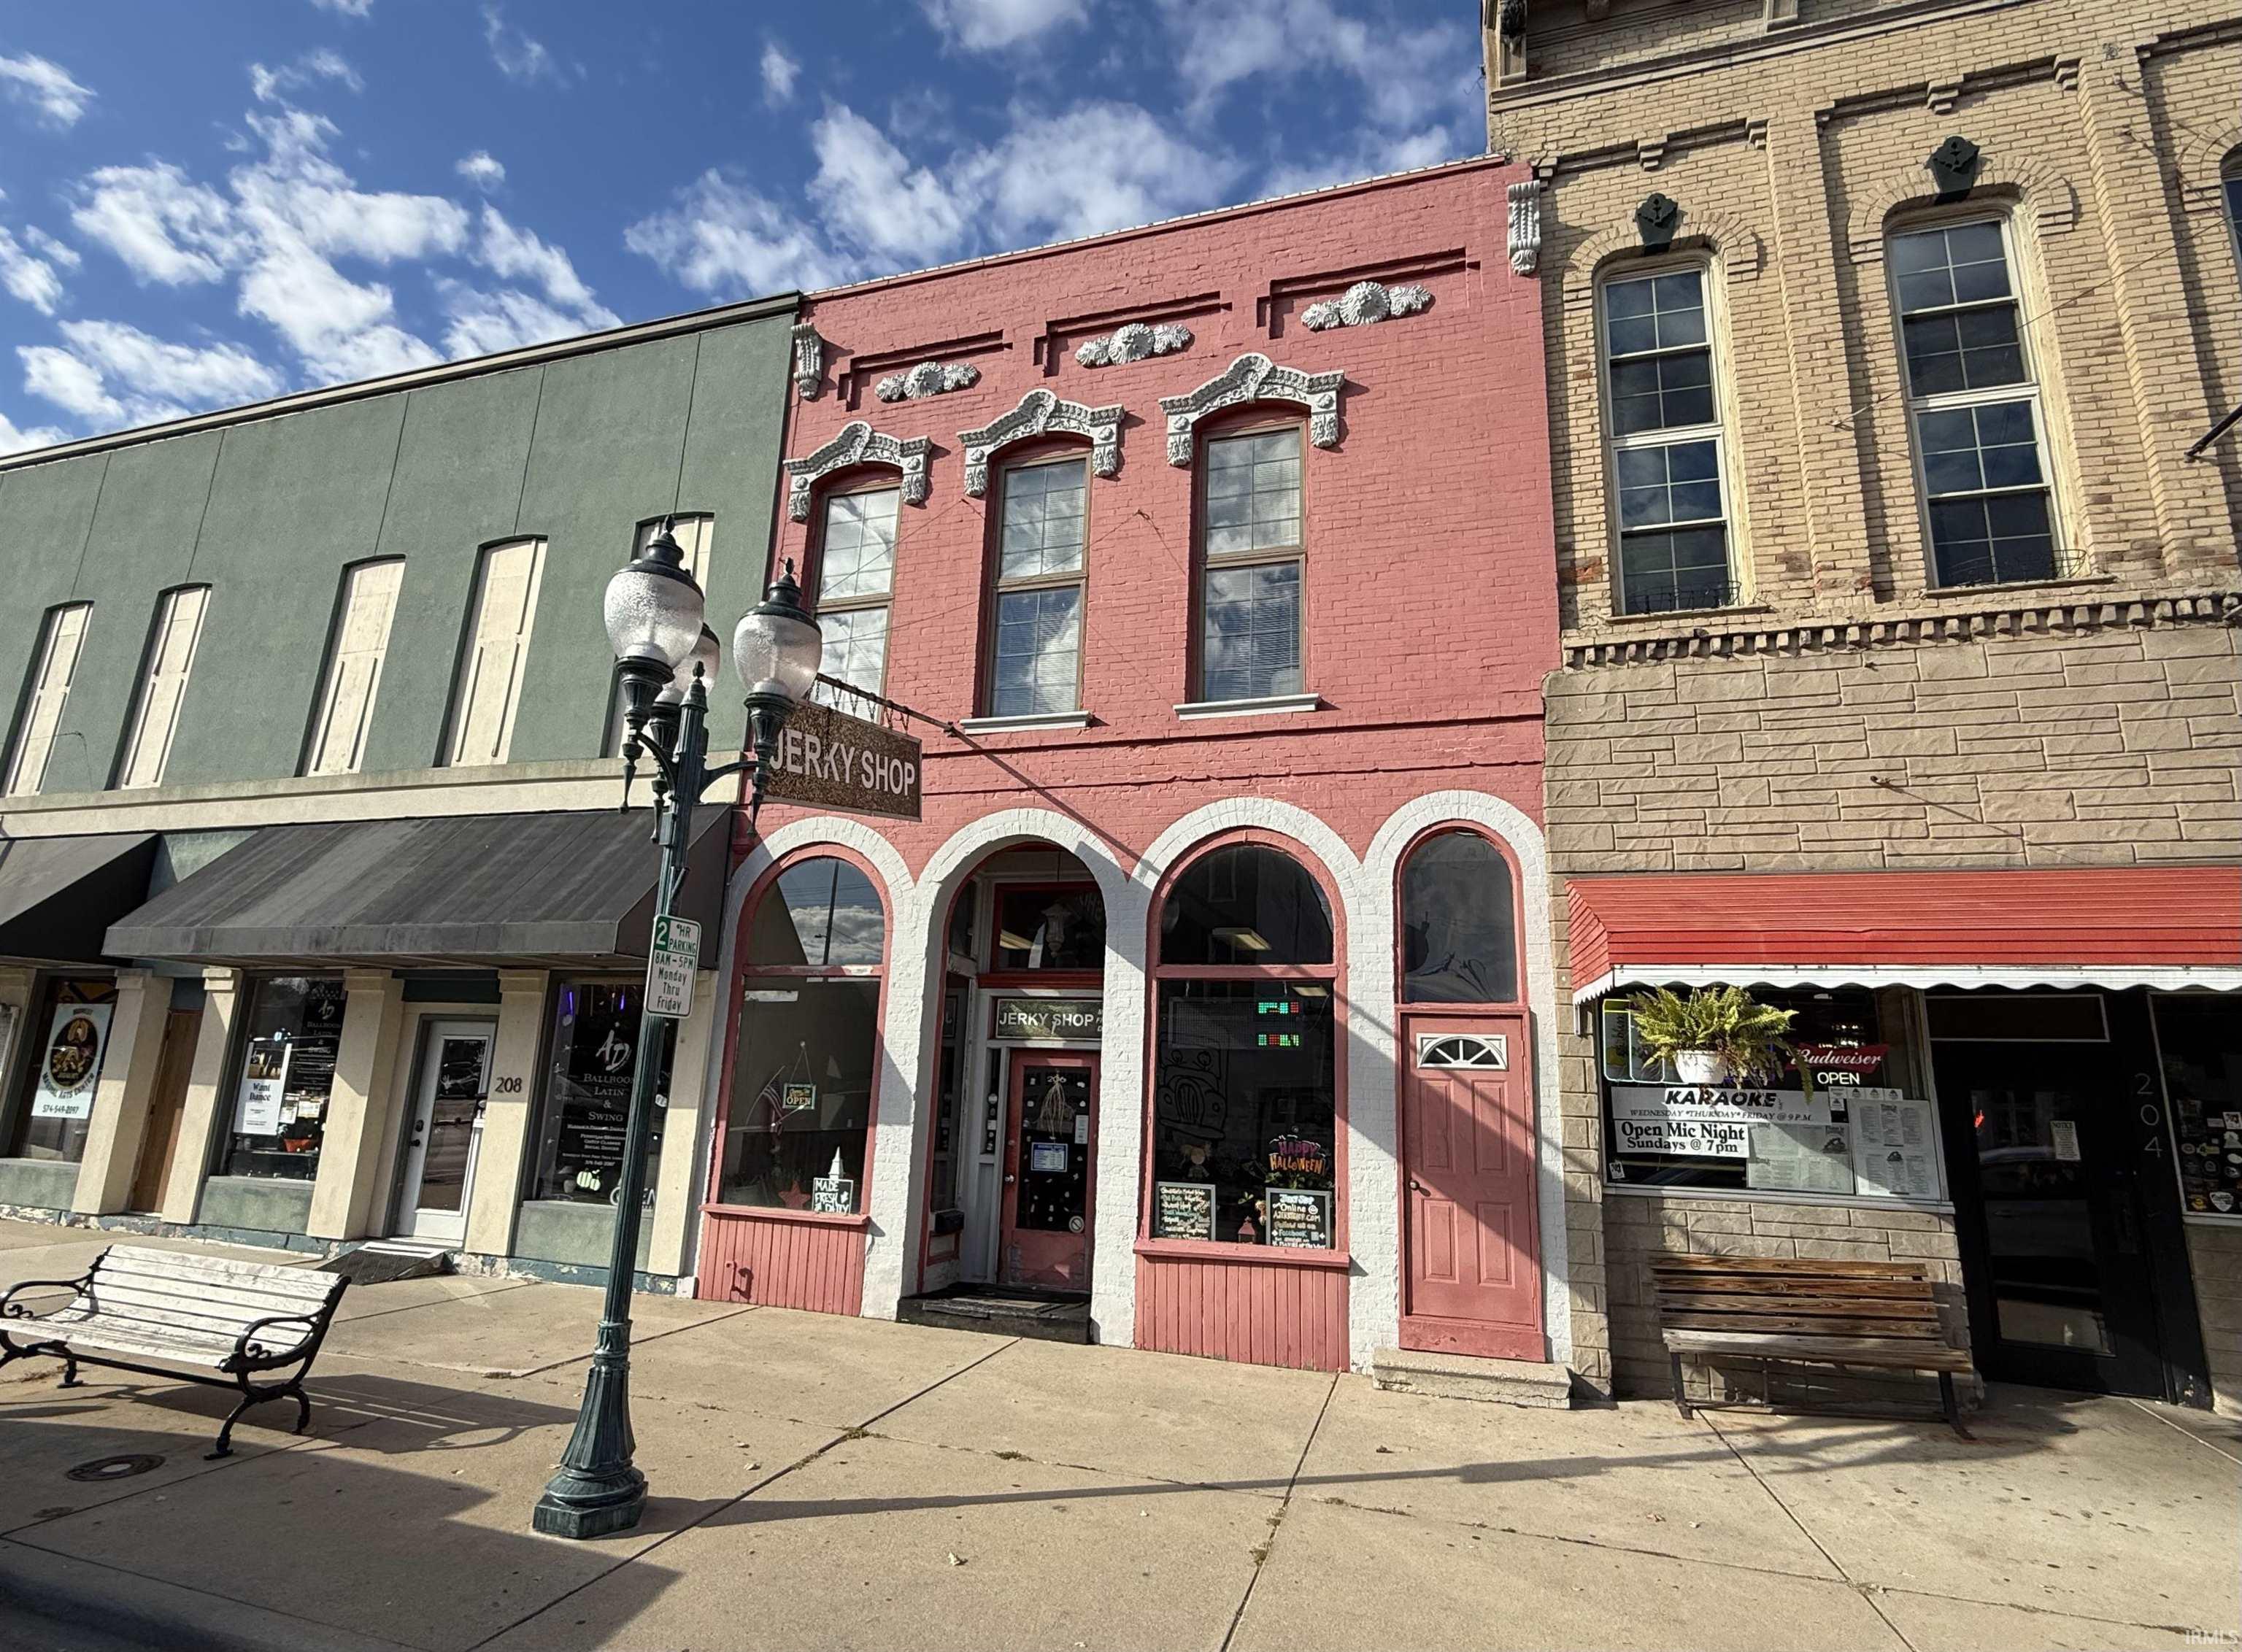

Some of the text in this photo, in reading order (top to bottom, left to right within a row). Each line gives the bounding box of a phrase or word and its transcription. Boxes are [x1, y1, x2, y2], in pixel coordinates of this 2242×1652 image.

[769, 728, 915, 796] JERKY SHOP
[656, 921, 691, 946] 2 HR
[669, 938, 697, 954] PARKING
[658, 967, 687, 986] Monday
[663, 981, 680, 996] Thru
[657, 995, 682, 1013] Friday
[999, 1012, 1049, 1026] JERKY
[1052, 1014, 1094, 1027] SHOP
[1790, 1048, 1881, 1067] Budweiser
[495, 1077, 523, 1093] 208
[1817, 1071, 1861, 1085] OPEN
[595, 1086, 625, 1096] LATIN
[1665, 1090, 1778, 1108] KARAOKE
[603, 1099, 612, 1108] &
[786, 1096, 812, 1105] OPEN
[588, 1111, 624, 1122] SWING
[1630, 1109, 1684, 1117] WEDNESDAY
[1742, 1111, 1776, 1120] FRIDAY
[1776, 1113, 1787, 1121] @
[1621, 1121, 1745, 1143] Open Mic Night
[1279, 1140, 1318, 1156] HAPPY
[1627, 1137, 1686, 1153] Sundays
[1690, 1138, 1702, 1151] @
[1270, 1153, 1322, 1175] HALLOWEEN
[814, 1180, 839, 1192] MADE
[814, 1192, 839, 1204] FRESH
[1280, 1203, 1306, 1213] Online
